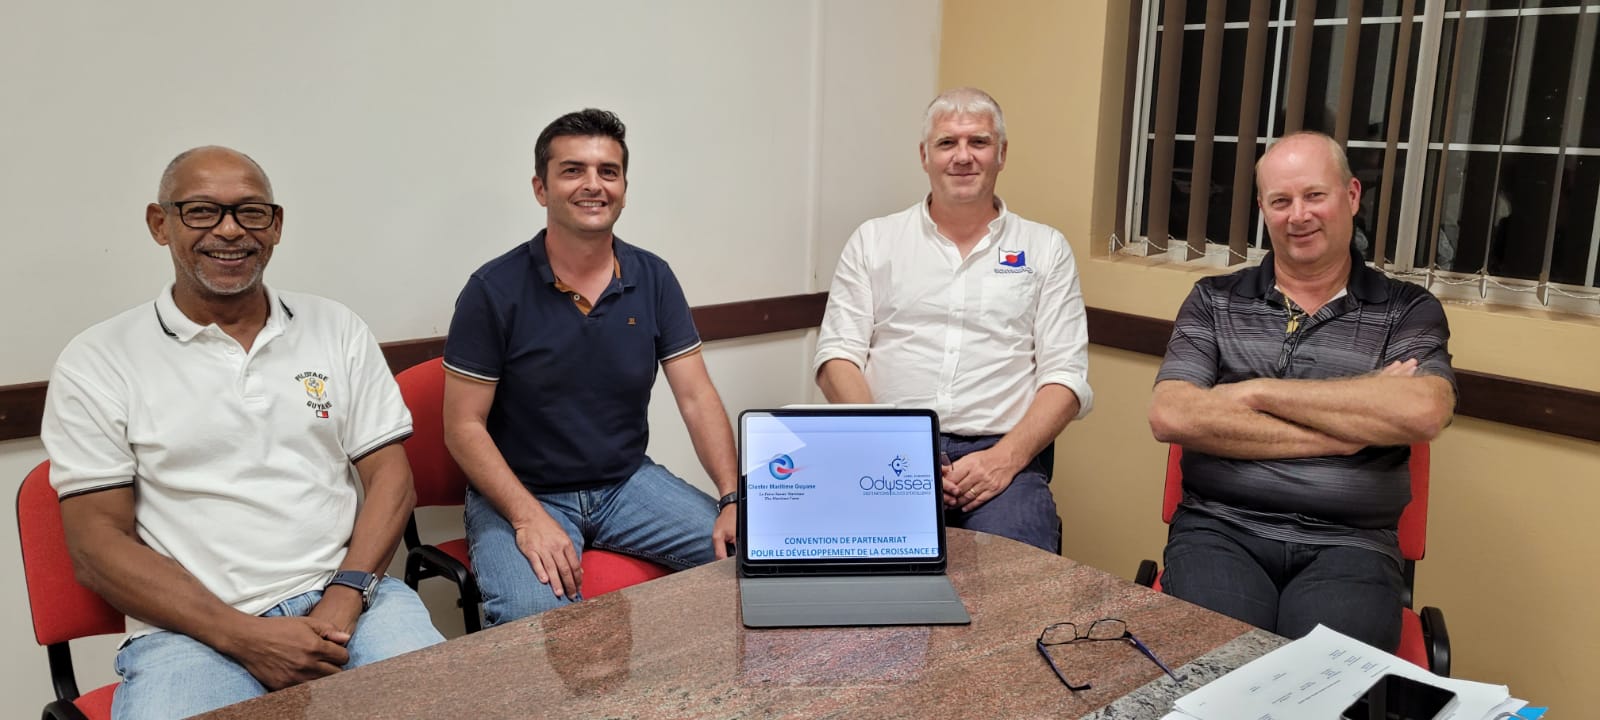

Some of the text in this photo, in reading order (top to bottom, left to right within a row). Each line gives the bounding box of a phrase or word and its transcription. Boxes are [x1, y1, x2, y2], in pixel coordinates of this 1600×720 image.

[784, 536, 907, 545] CONVENTION DE PARTENARIAT
[751, 547, 938, 557] POUR LE DÉVELOPPEMENT DE LA CROISSANCE E
